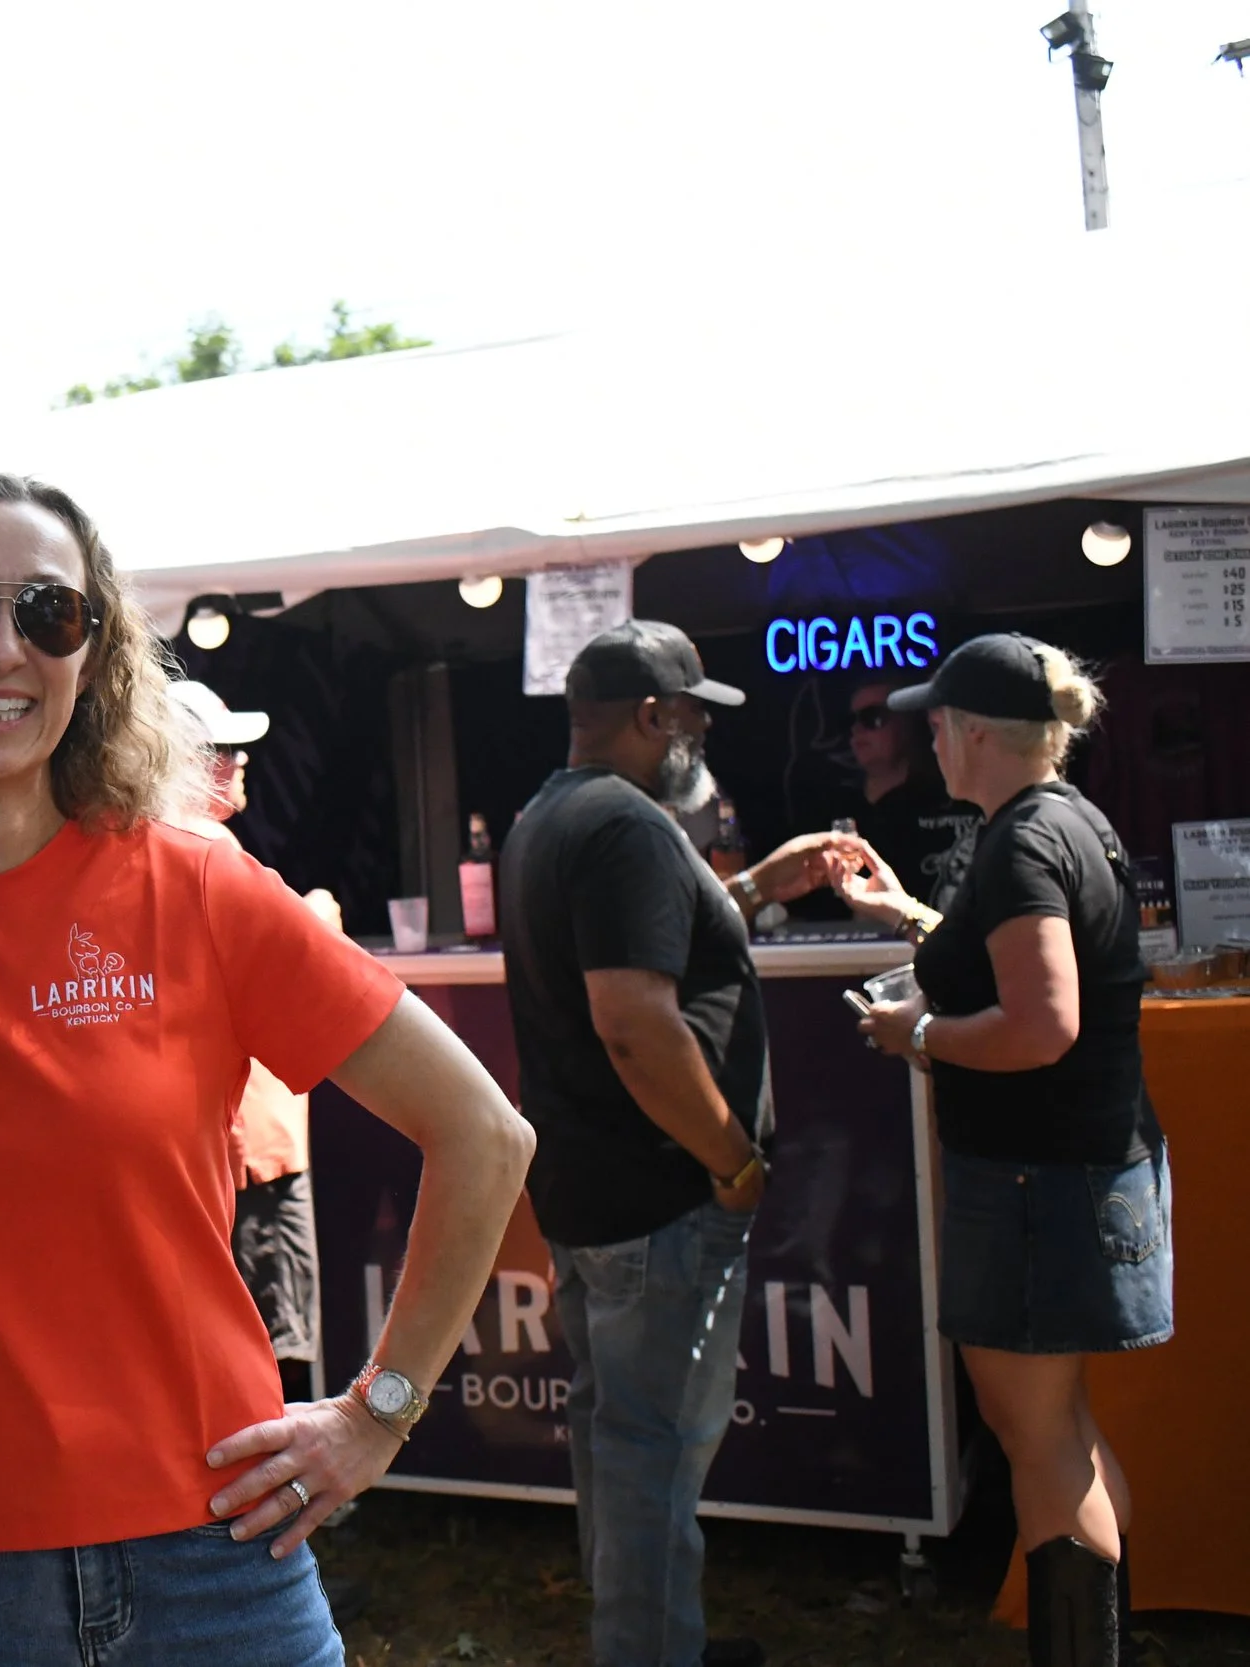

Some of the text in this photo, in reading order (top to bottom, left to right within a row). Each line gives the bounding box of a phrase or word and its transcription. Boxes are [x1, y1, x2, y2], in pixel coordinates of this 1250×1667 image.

[766, 612, 939, 673] CIGARS
[31, 973, 155, 1012] LARRIKIN
[51, 1001, 111, 1019] BOURBON
[66, 1013, 121, 1028] KENTUCKY
